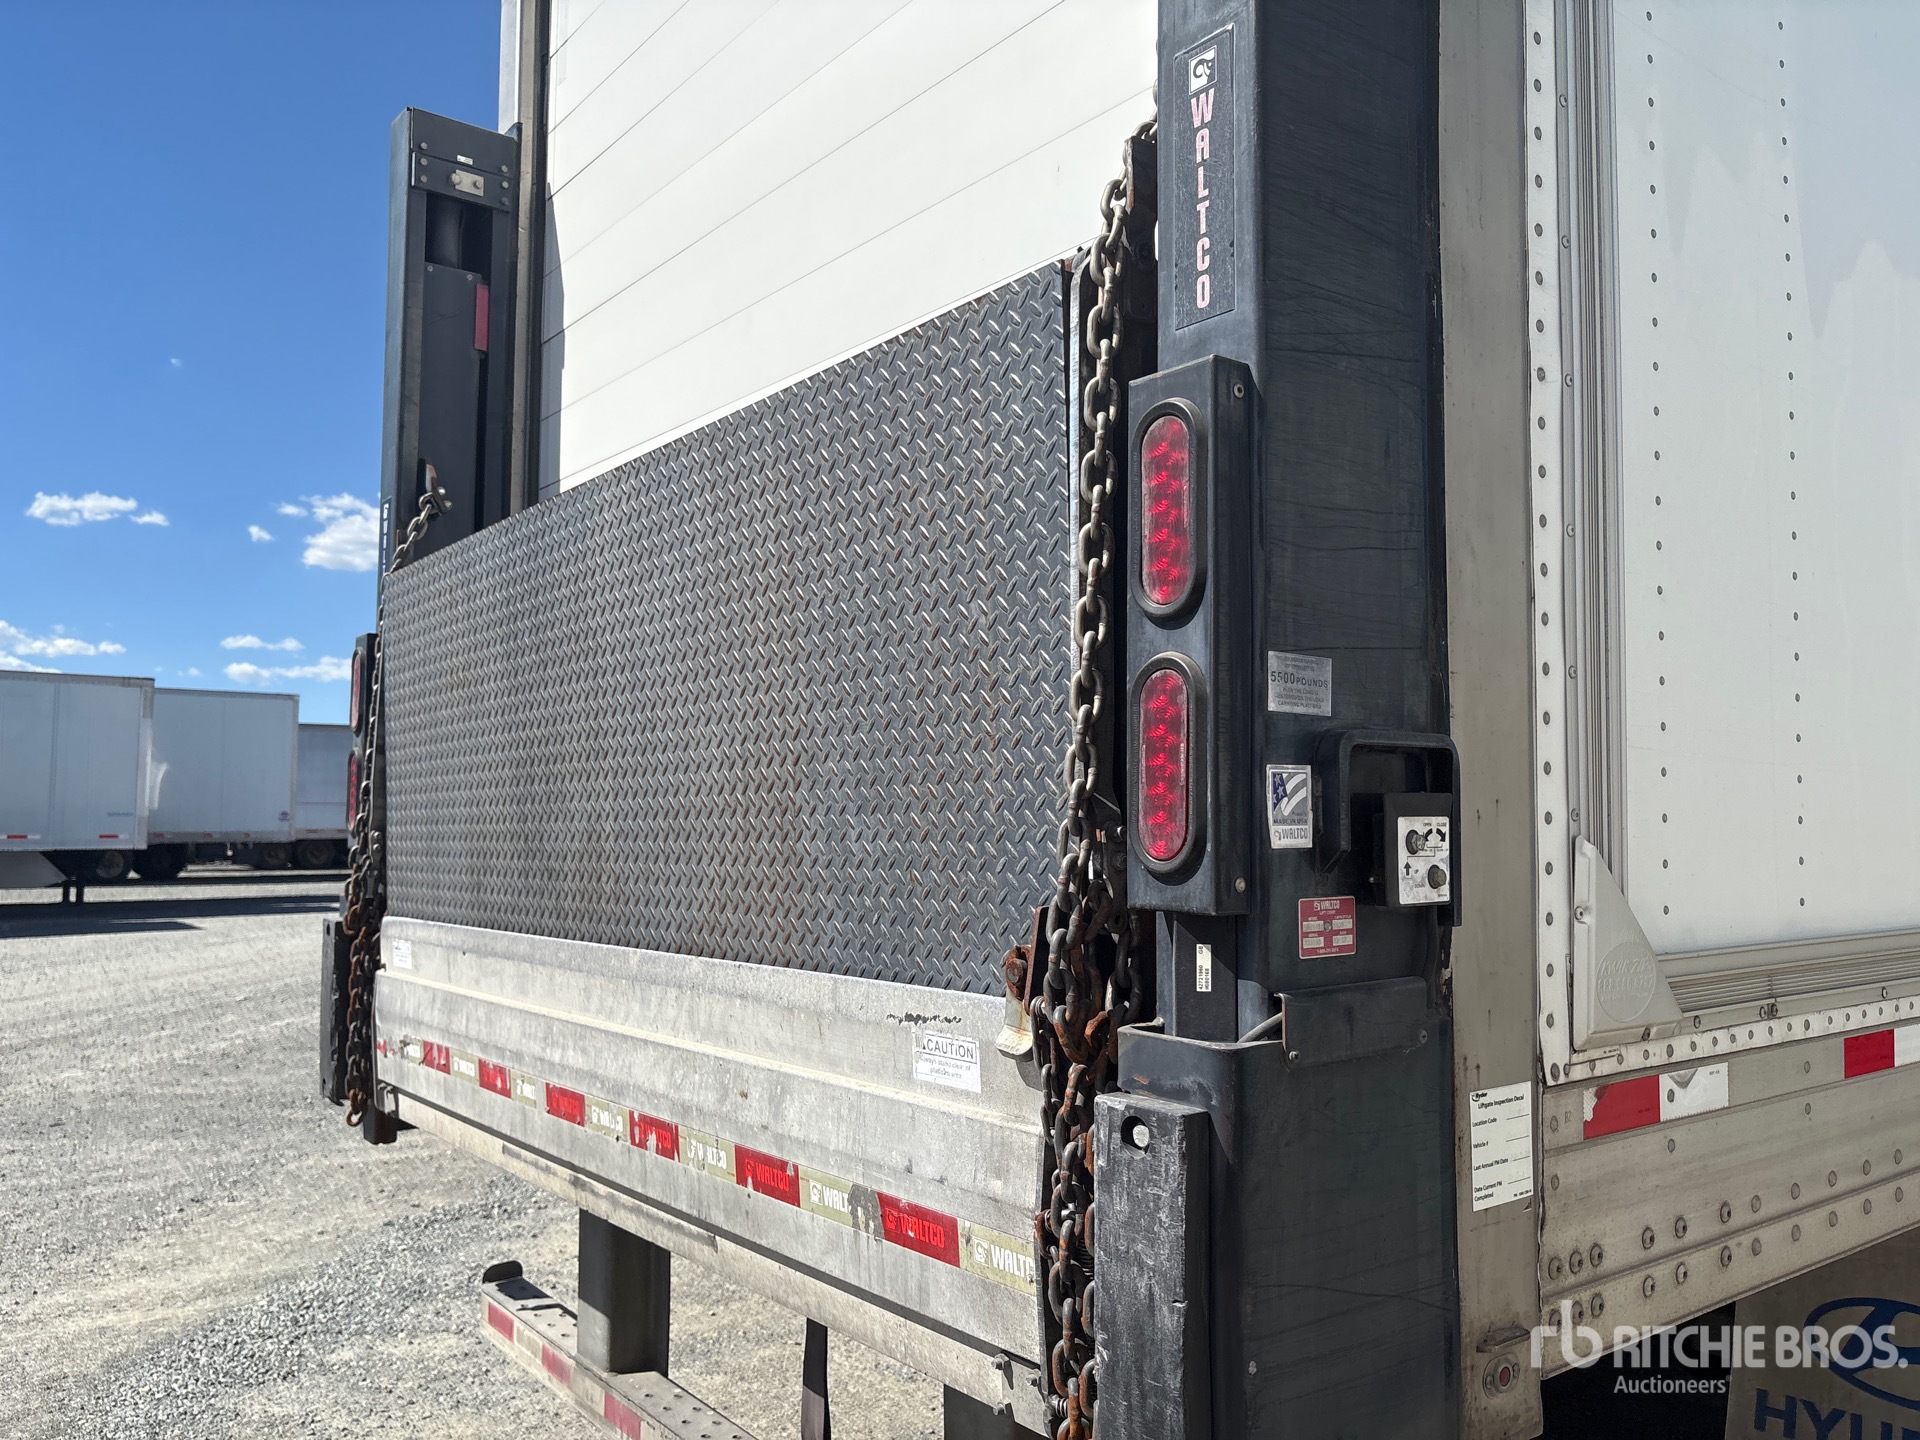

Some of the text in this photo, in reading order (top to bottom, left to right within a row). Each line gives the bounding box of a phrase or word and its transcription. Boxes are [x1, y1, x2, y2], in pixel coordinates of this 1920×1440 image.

[1190, 88, 1215, 309] WALTCO
[1270, 670, 1328, 689] 5500 POUNDS
[1282, 827, 1308, 840] WALTCO
[1320, 900, 1340, 910] WALTCO
[926, 1038, 974, 1060] CAUTION
[1493, 1097, 1514, 1106] Inspection
[1513, 1093, 1524, 1102] Decal
[1472, 1119, 1488, 1127] Location
[1481, 1161, 1494, 1169] Annual
[756, 1163, 790, 1192] WALTCO
[1482, 1182, 1497, 1191] Current
[1474, 1191, 1494, 1202] Completed
[900, 1212, 945, 1249] WALTCO
[990, 1244, 1035, 1281] WALTC
[1754, 1388, 1920, 1440] HYU
